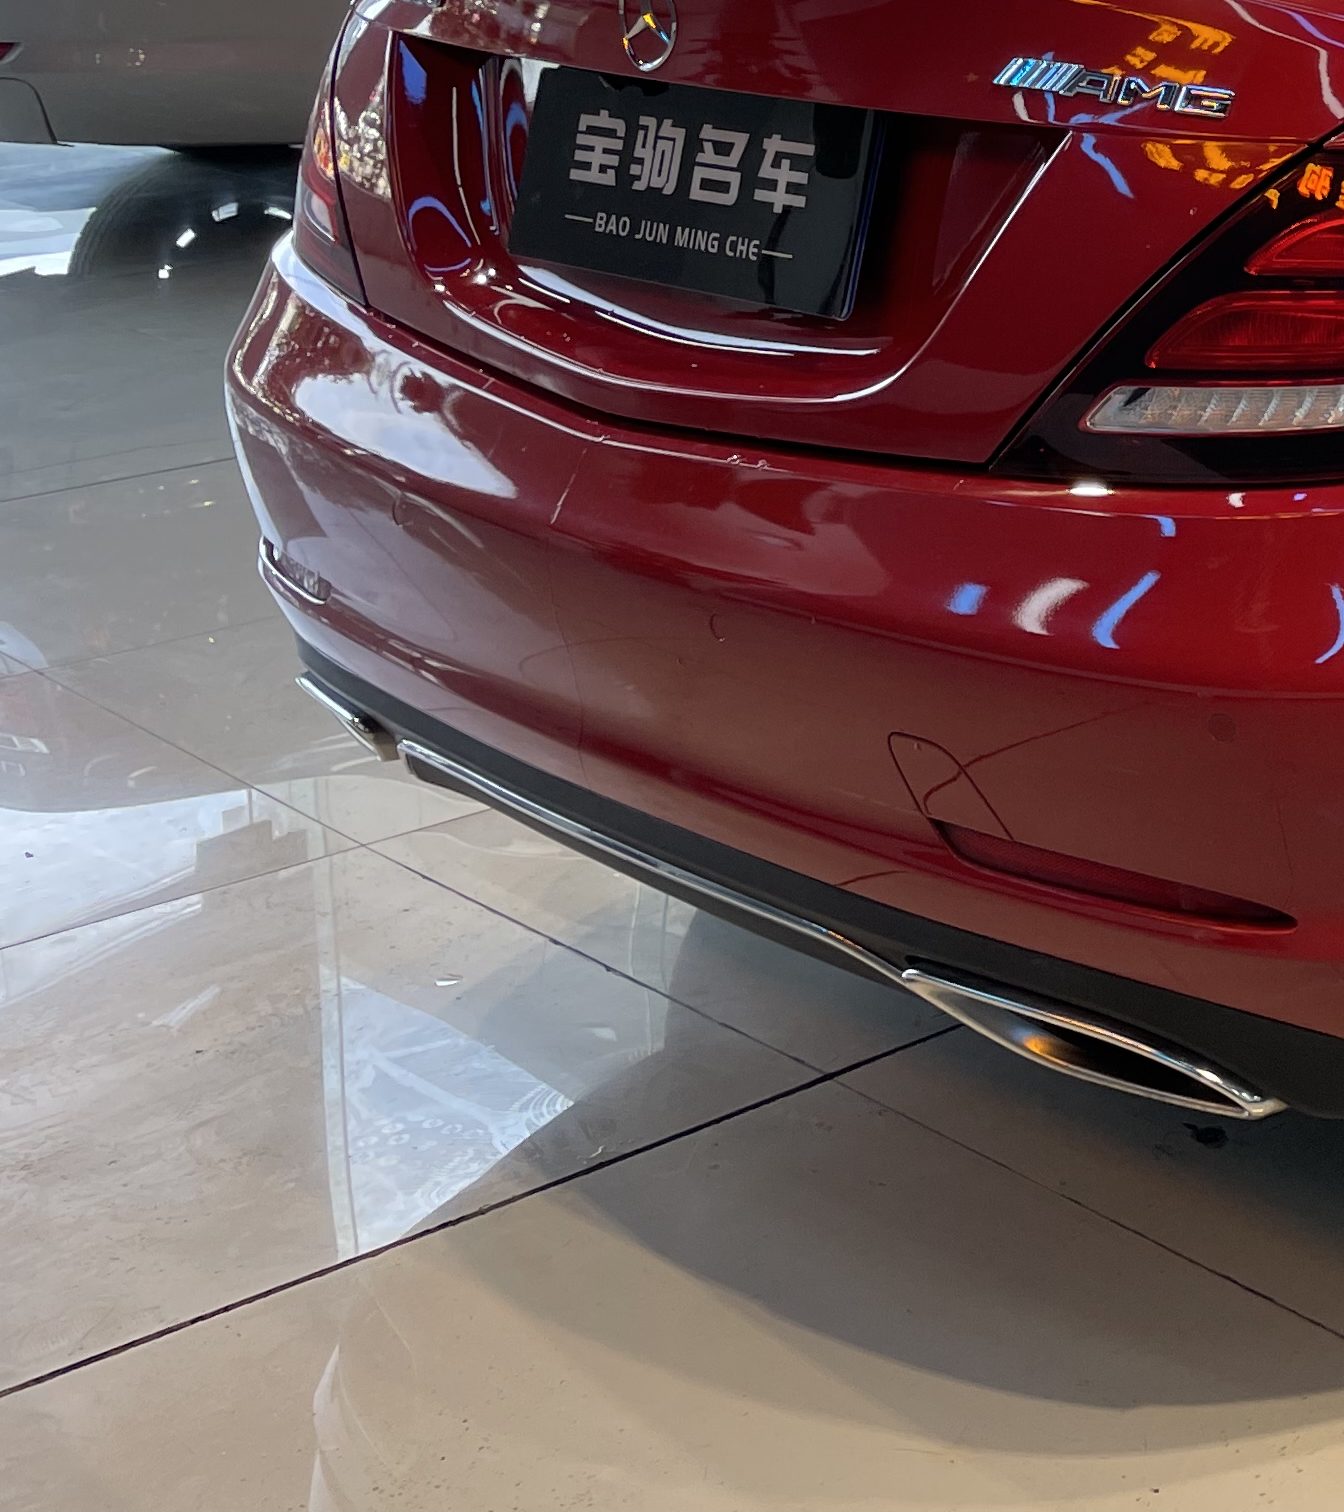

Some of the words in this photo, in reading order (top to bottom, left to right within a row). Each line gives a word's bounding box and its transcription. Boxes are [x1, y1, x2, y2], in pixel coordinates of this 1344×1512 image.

[568, 109, 816, 214] 宝驹名车
[594, 211, 630, 237] BAO
[634, 219, 670, 245] JUN
[674, 225, 720, 254] MING
[725, 235, 761, 262] CHE
